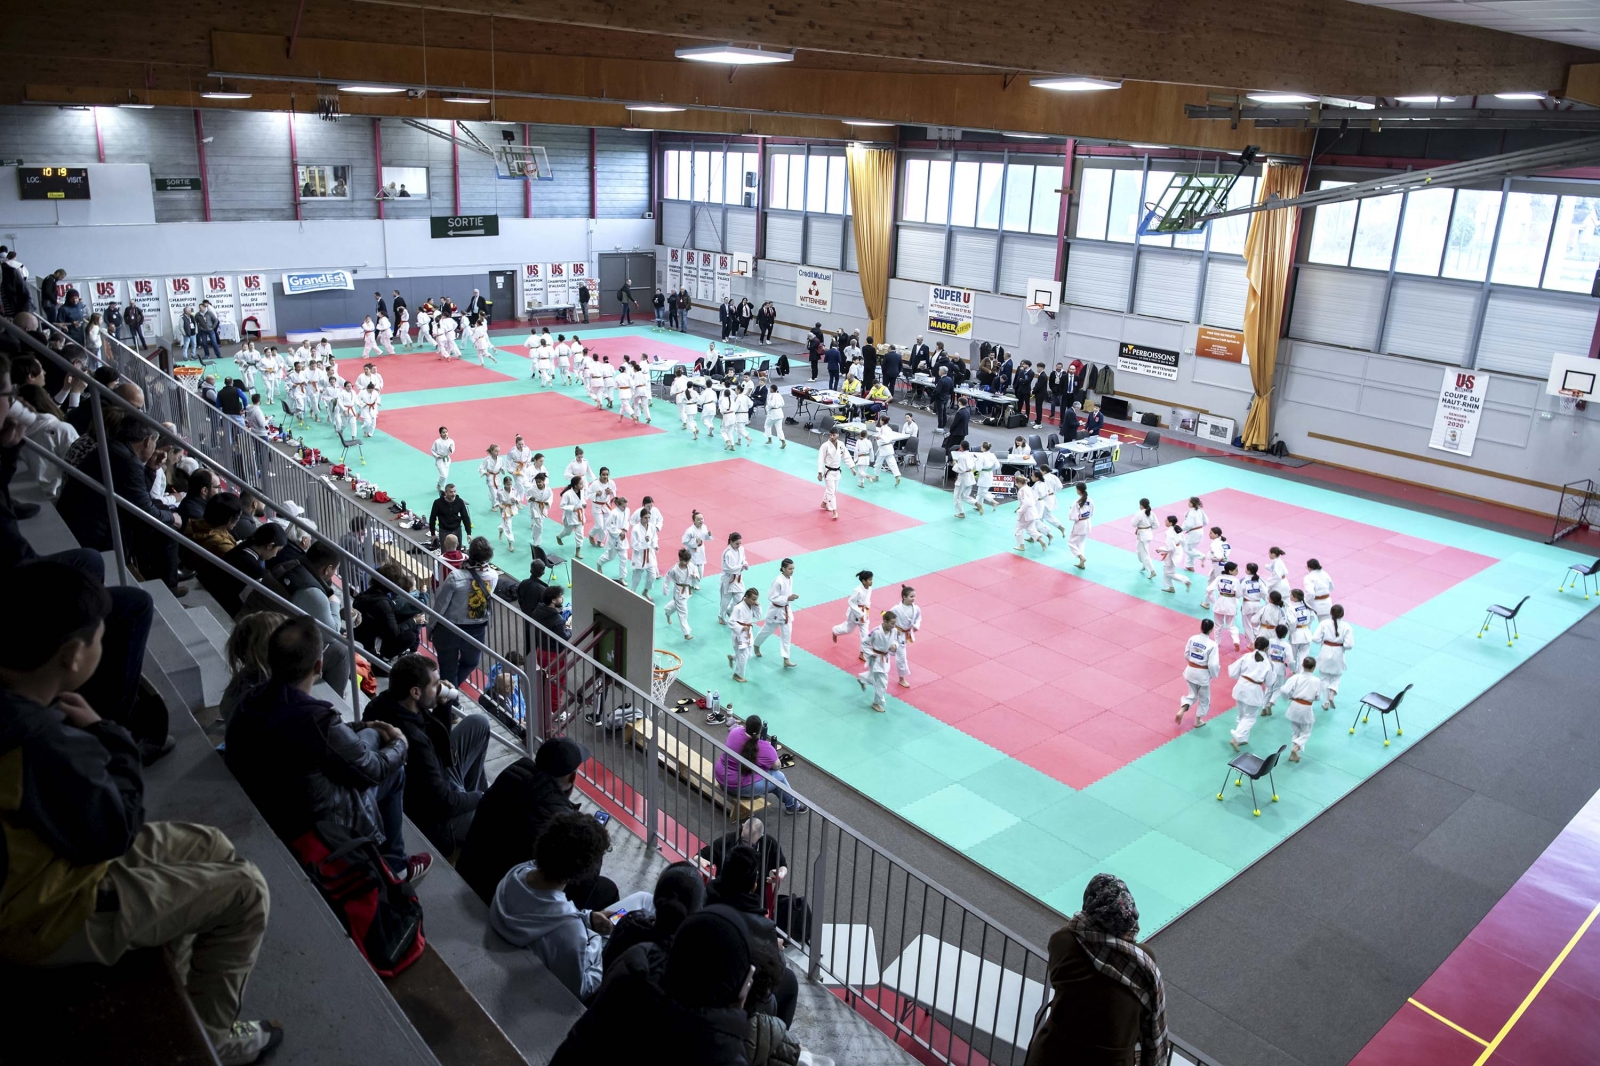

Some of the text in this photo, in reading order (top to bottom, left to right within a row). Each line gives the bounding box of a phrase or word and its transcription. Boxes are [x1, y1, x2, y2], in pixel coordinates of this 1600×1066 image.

[42, 168, 67, 177] 10 19
[448, 216, 484, 227] SORTIE
[527, 264, 538, 275] US
[552, 264, 563, 274] US
[573, 263, 584, 274] US
[135, 281, 152, 294] US
[172, 278, 190, 291] US
[210, 277, 225, 290] US
[244, 276, 260, 288] US
[97, 282, 115, 295] US
[800, 296, 827, 306] WITTENHEIM
[934, 288, 970, 303] SUPER U
[931, 321, 956, 330] MADER
[1456, 373, 1475, 389] US
[1444, 392, 1468, 401] COUPE
[1442, 398, 1479, 410] HAUT-RHIN
[1115, 450, 1118, 460] 1
